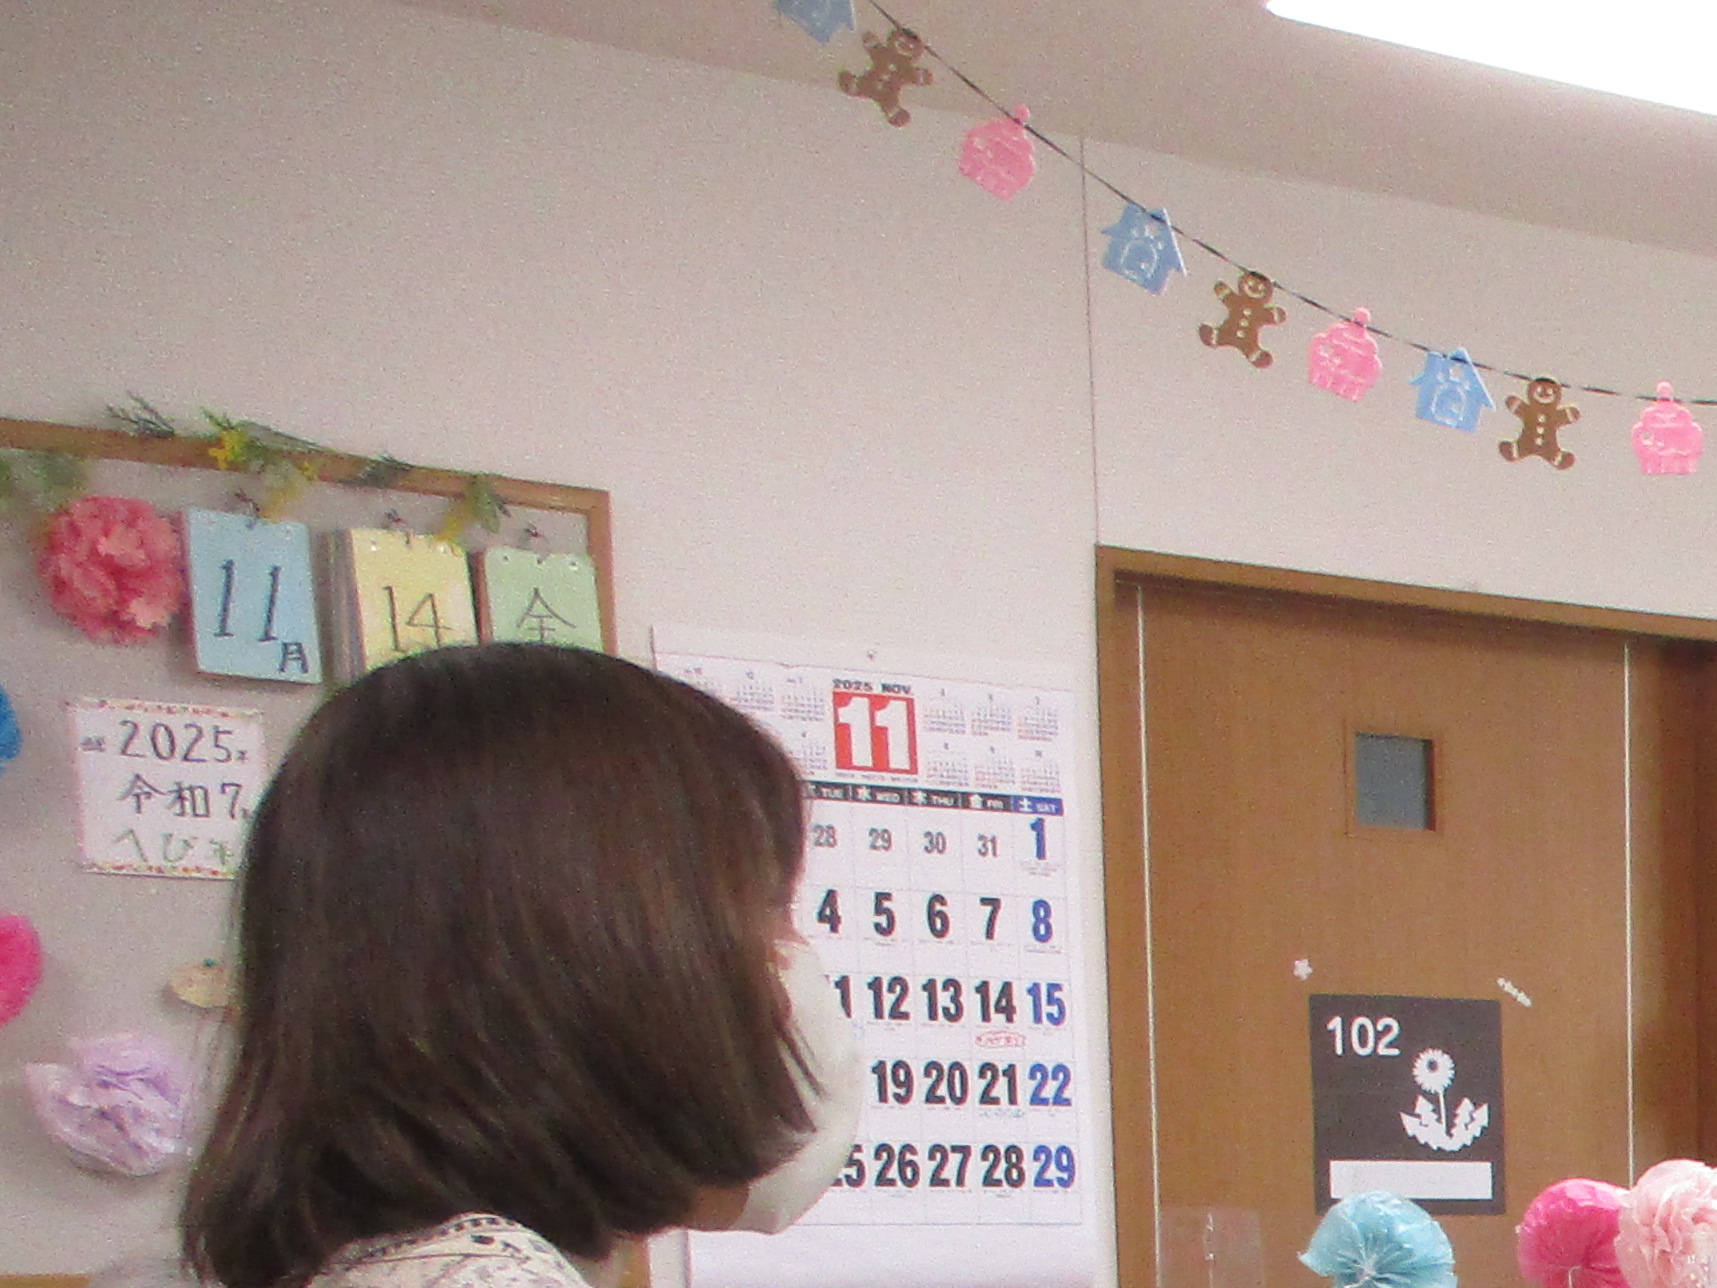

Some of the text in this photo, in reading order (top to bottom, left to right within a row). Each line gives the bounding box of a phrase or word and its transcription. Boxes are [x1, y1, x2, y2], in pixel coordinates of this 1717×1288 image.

[384, 585, 453, 651] 14
[833, 678, 873, 691] 2025
[837, 696, 911, 770] 11
[117, 774, 250, 820] 令和7
[813, 817, 1047, 860] 28 29 30 31 1
[817, 889, 1052, 943] 4 5 6 7 8
[824, 974, 1066, 1026] 1 12 13 14 15
[1327, 1015, 1401, 1057] 102
[871, 1060, 1072, 1106] 19 20 21 22
[874, 1143, 920, 1188] 26
[928, 1145, 971, 1187] 27
[981, 1144, 1025, 1188] 28
[1033, 1145, 1075, 1188] 29
